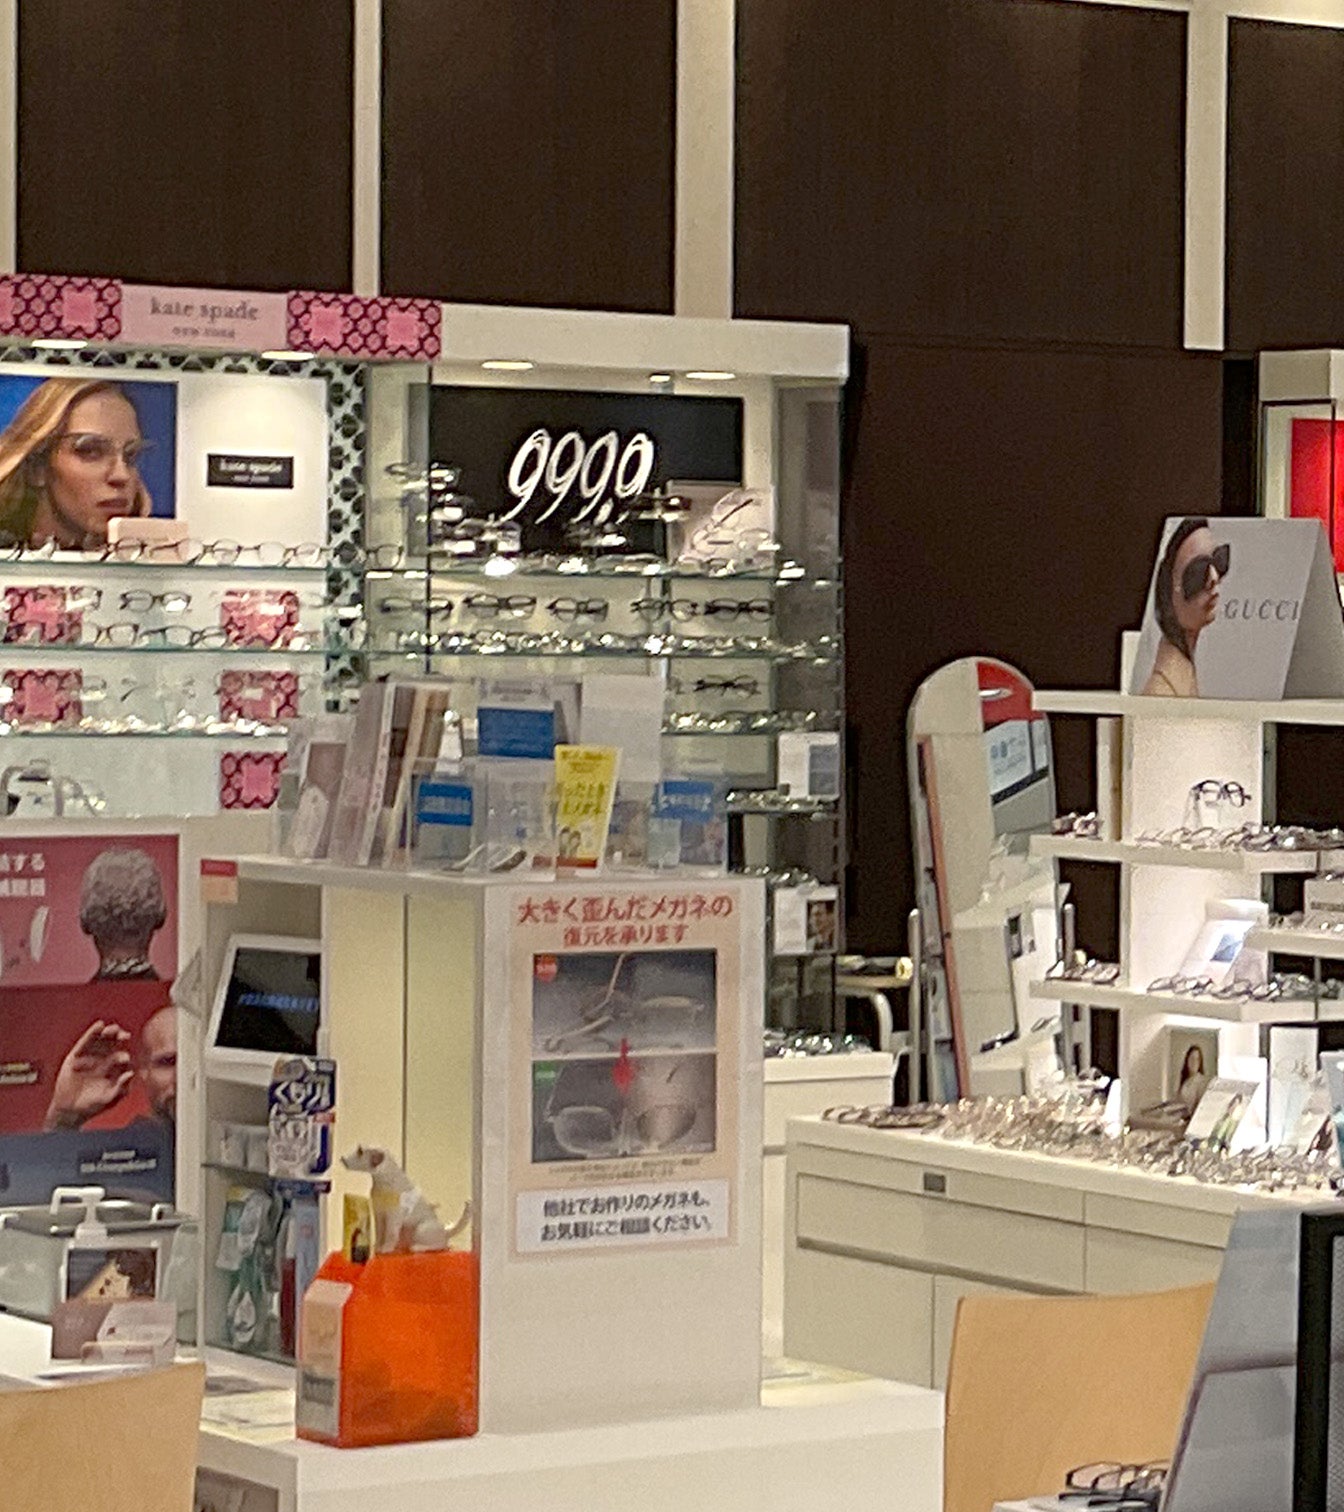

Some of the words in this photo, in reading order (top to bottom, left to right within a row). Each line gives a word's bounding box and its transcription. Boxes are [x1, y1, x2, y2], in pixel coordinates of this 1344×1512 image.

[150, 297, 194, 318] kate
[199, 300, 259, 323] spade
[1223, 598, 1301, 622] GUCCI
[517, 895, 733, 925] 大きく歪んだメガネの
